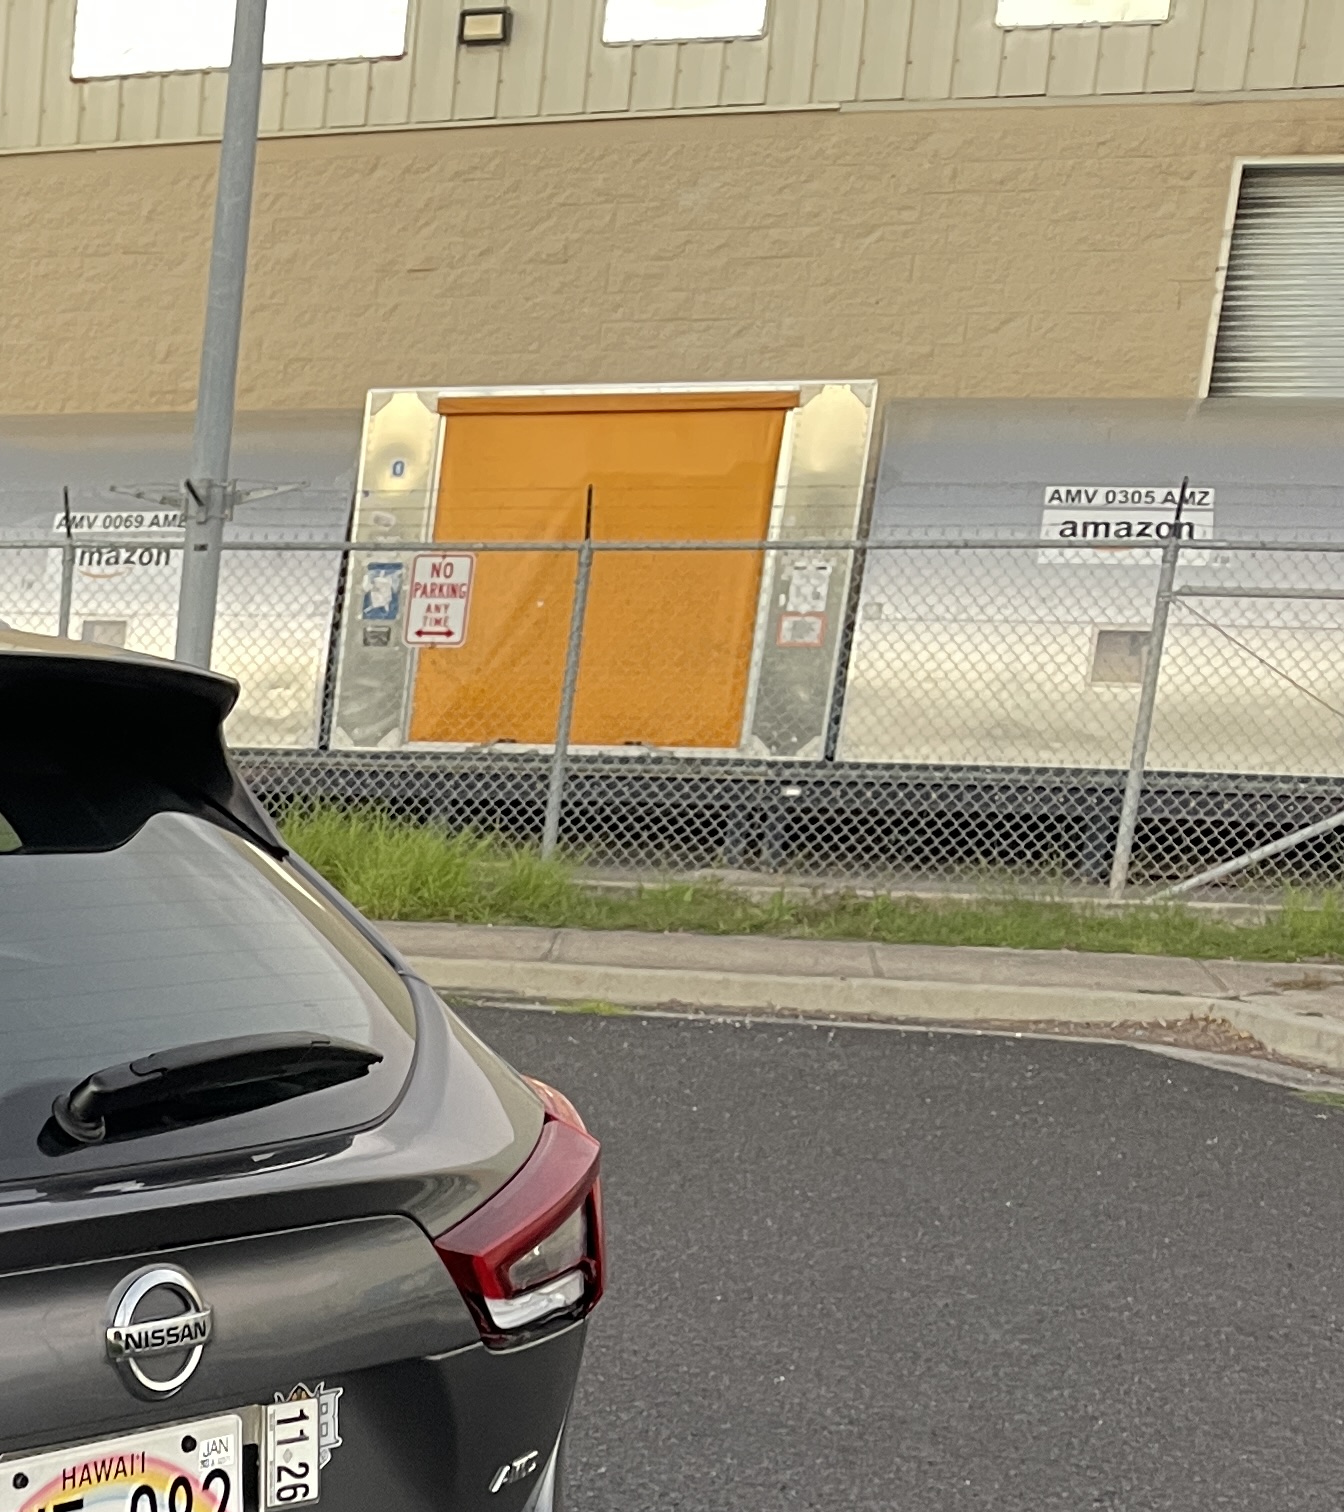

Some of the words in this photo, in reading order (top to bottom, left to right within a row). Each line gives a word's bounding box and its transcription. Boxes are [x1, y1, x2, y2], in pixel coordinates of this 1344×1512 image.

[1047, 488, 1099, 504] AMV
[1104, 489, 1157, 505] 0305
[1161, 490, 1211, 506] AMZ
[102, 513, 145, 529] 0069
[1058, 519, 1195, 541] amazon
[430, 561, 454, 579] NO
[413, 581, 468, 599] PARKING
[425, 602, 451, 614] ANY
[422, 615, 450, 628] TIME
[124, 1319, 207, 1351] NISSAN
[276, 1408, 310, 1446] 11
[202, 1436, 229, 1458] JAN
[276, 1462, 310, 1502] 26
